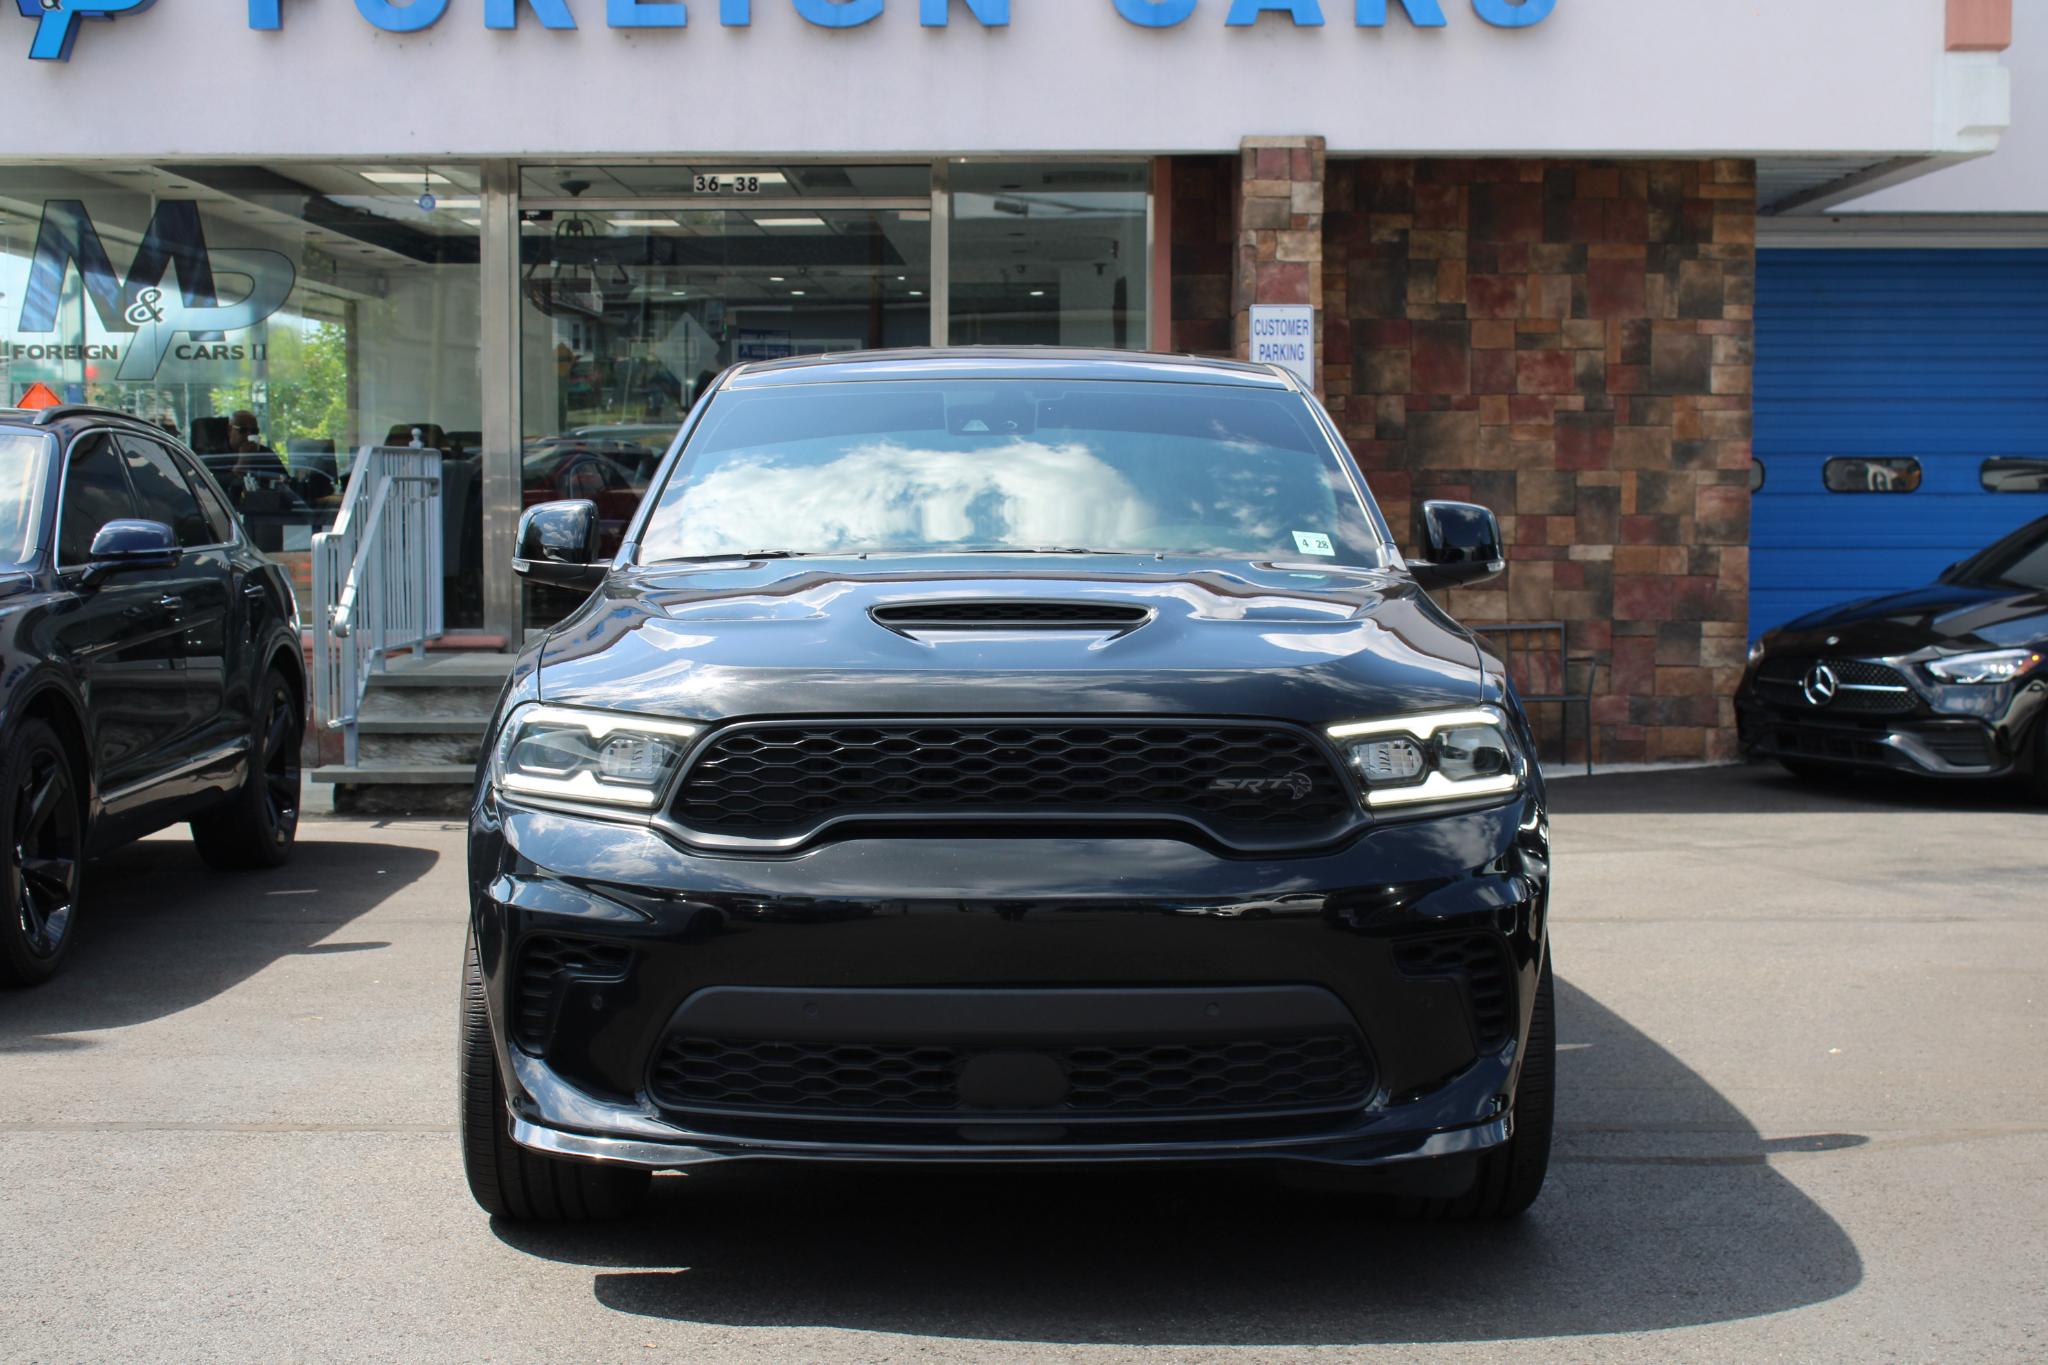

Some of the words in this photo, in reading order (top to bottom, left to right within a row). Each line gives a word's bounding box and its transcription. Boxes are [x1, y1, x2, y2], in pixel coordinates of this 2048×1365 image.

[695, 176, 758, 192] 36-38
[1254, 319, 1309, 336] CUSTOMER
[12, 344, 118, 361] FOREIGN
[175, 344, 244, 361] CARS
[1260, 343, 1304, 361] PARKING
[1208, 778, 1293, 793] SRT
